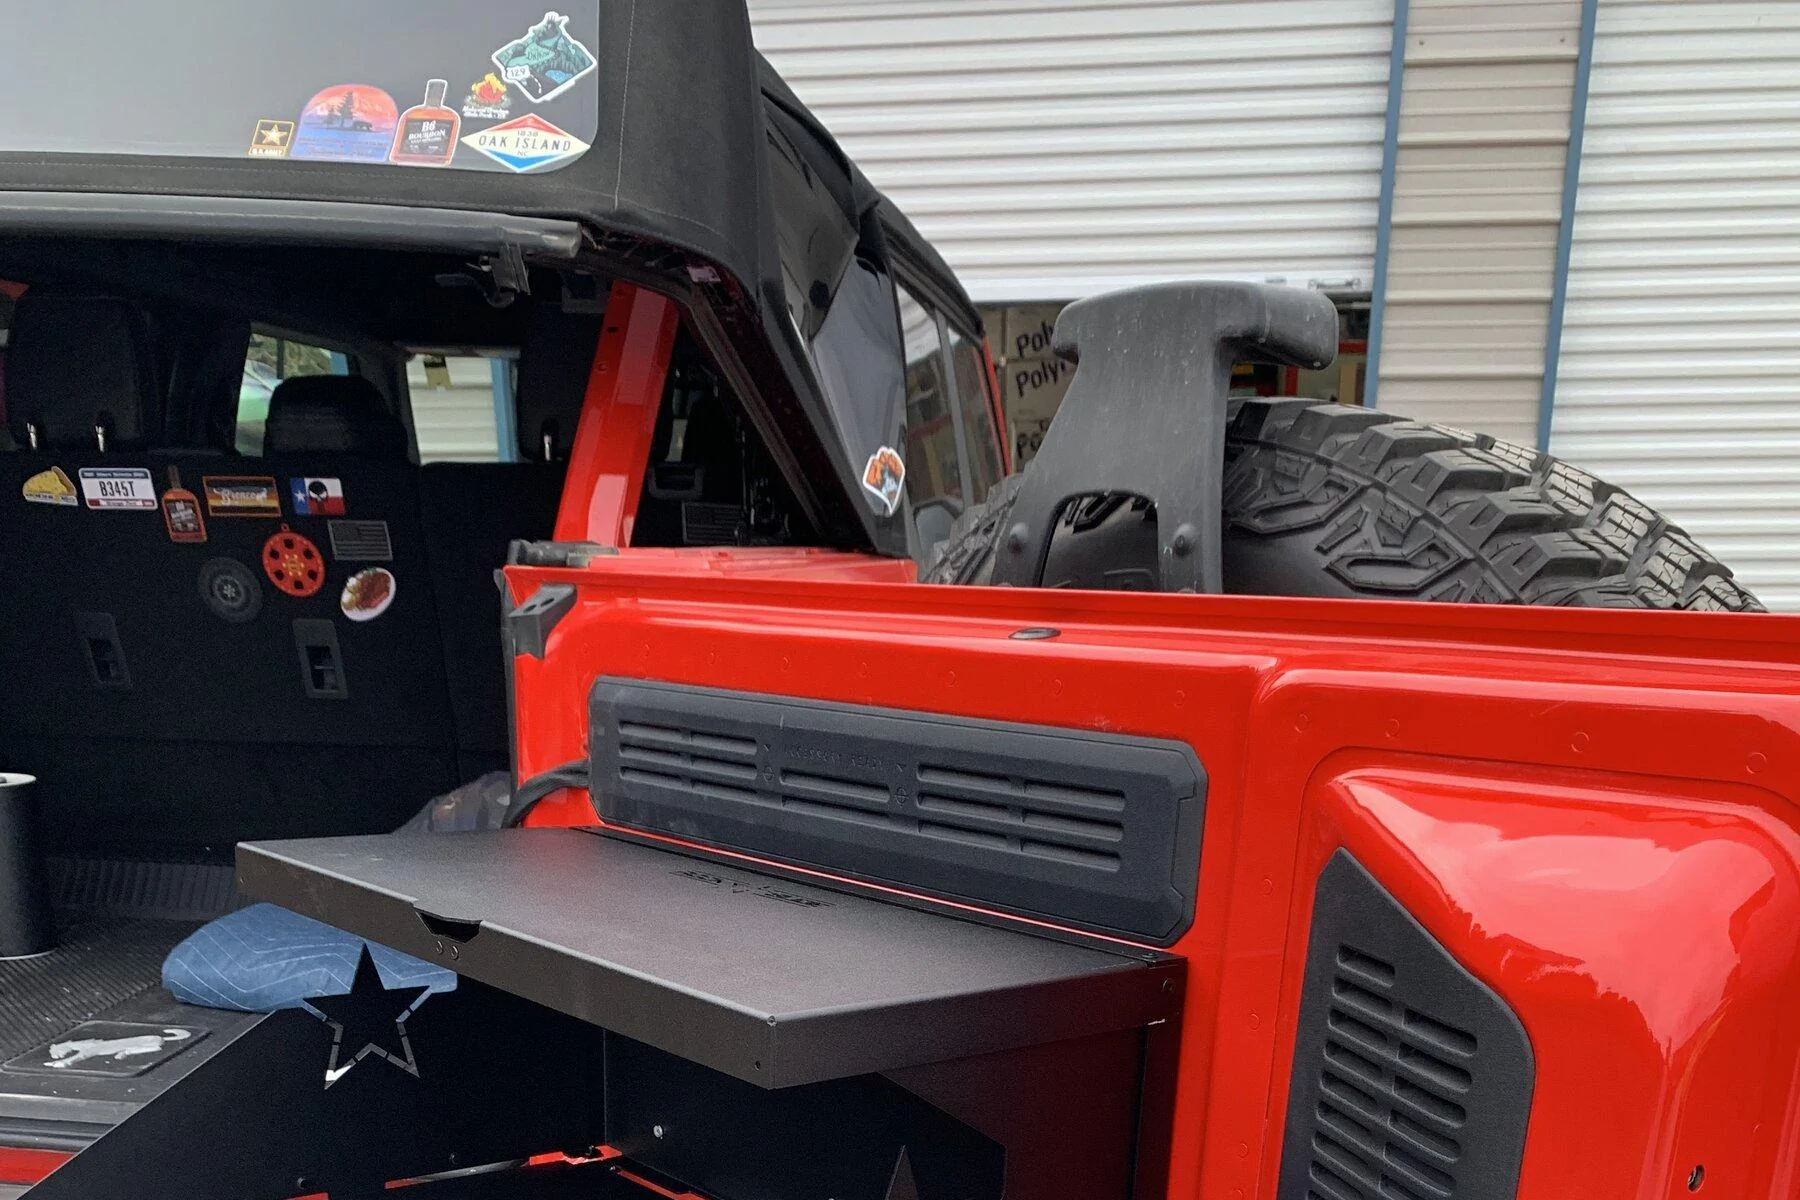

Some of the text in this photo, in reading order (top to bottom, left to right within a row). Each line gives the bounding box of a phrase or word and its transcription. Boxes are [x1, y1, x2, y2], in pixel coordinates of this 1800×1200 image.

[511, 68, 526, 77] 129
[478, 135, 572, 152] OAK ISLAND
[1016, 360, 1067, 398] Poly
[98, 480, 136, 497] B345T
